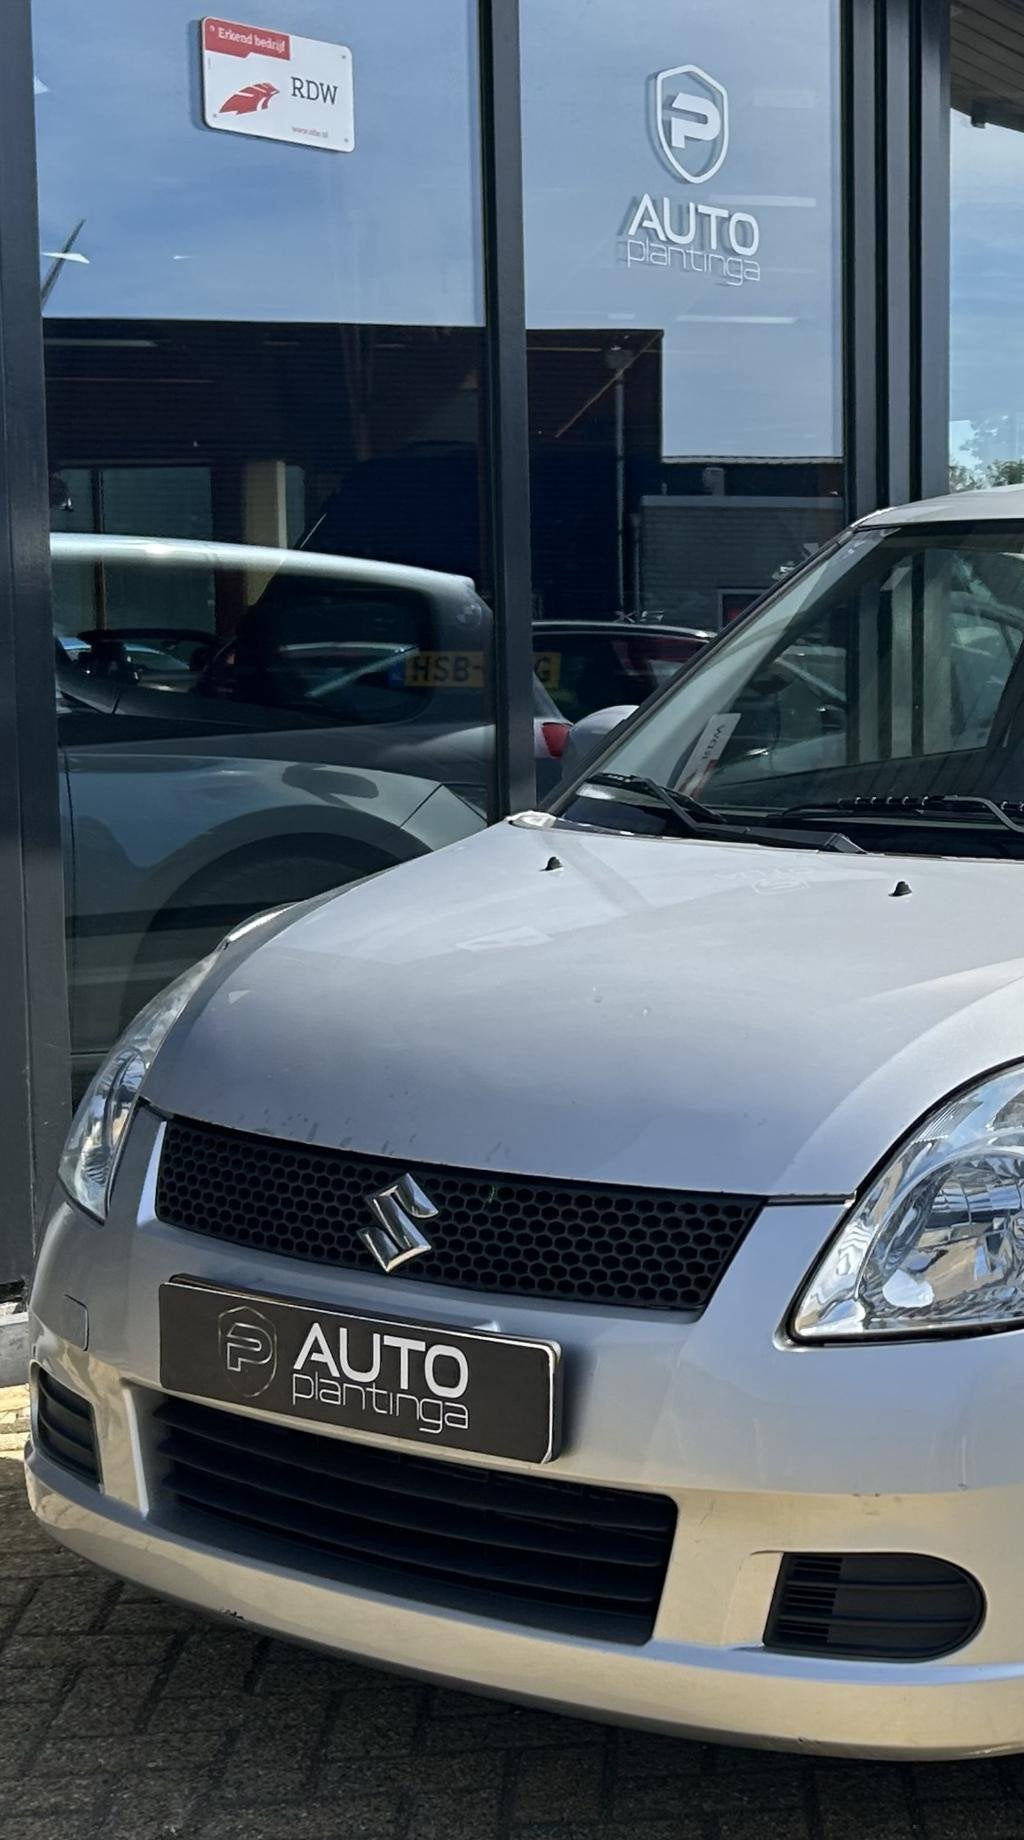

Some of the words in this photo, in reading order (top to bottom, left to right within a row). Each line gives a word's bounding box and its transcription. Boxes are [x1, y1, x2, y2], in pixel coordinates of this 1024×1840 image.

[217, 27, 253, 46] Erkend
[254, 34, 286, 54] bedrijf
[290, 76, 339, 106] RDW
[628, 193, 760, 257] AUTO
[627, 239, 761, 287] plantinga
[293, 1322, 470, 1399] AUTO
[292, 1371, 470, 1434] plantinga
